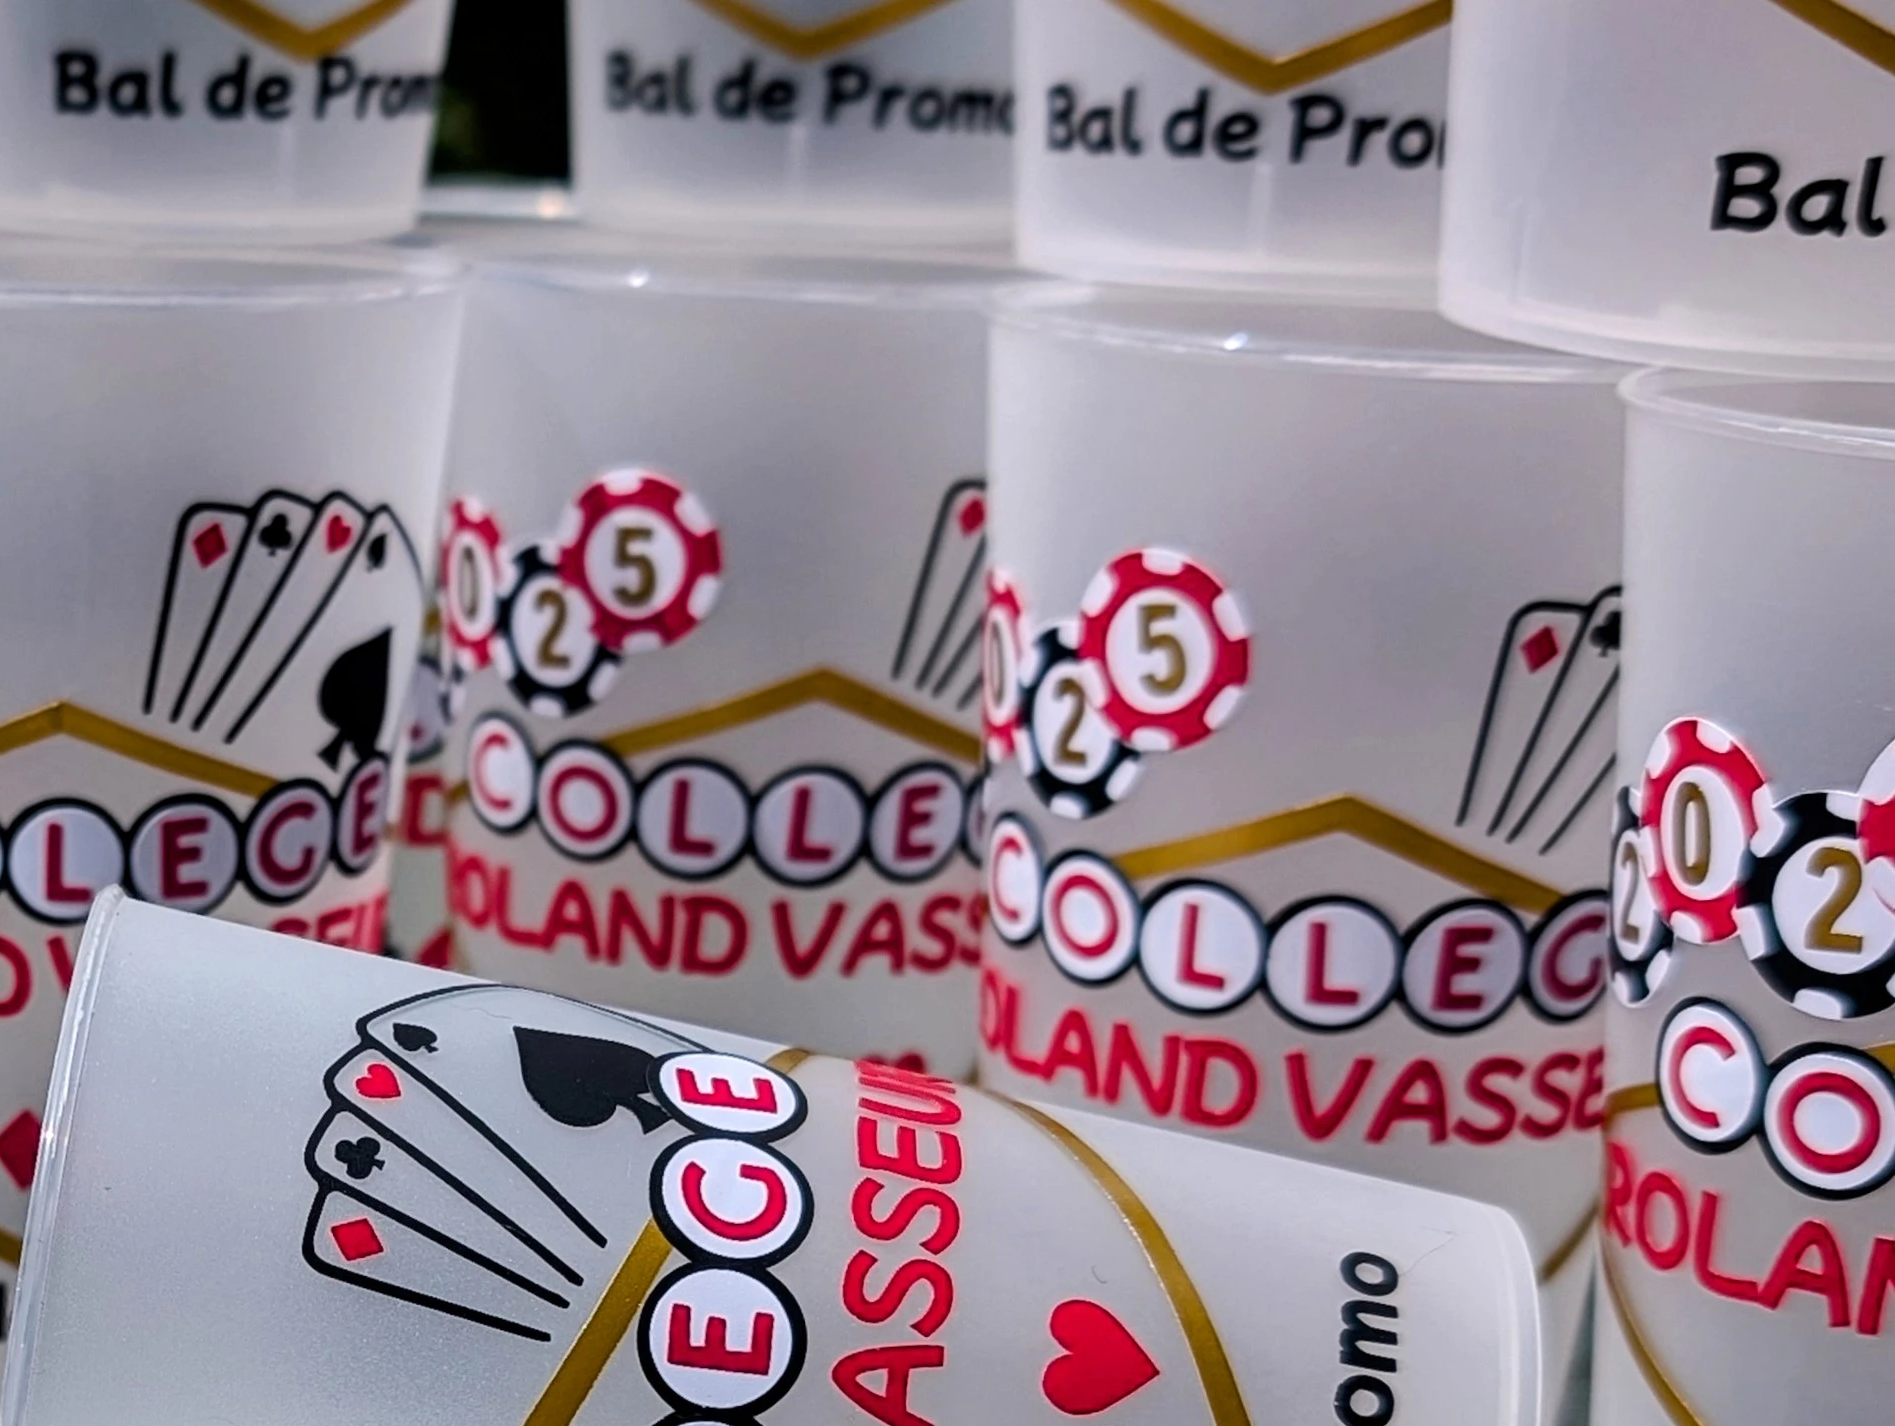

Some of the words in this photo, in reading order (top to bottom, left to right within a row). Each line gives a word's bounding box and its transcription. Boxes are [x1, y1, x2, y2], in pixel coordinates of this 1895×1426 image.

[55, 50, 184, 118] Bal
[203, 53, 293, 120] de
[607, 49, 696, 117] Bal
[713, 58, 798, 124] de
[1046, 83, 1143, 156] Bal
[1162, 87, 1260, 163] de
[1289, 94, 1446, 169] Pro
[1710, 151, 1887, 238] Bal
[535, 588, 572, 670] 2
[614, 526, 658, 608] 5
[1054, 676, 1087, 768] 2
[1138, 604, 1188, 697] 5
[473, 732, 983, 863] COLLE
[444, 838, 749, 977] OLAND
[1619, 841, 1641, 944] 2
[1672, 781, 1711, 886] 0
[1804, 845, 1864, 954] 2
